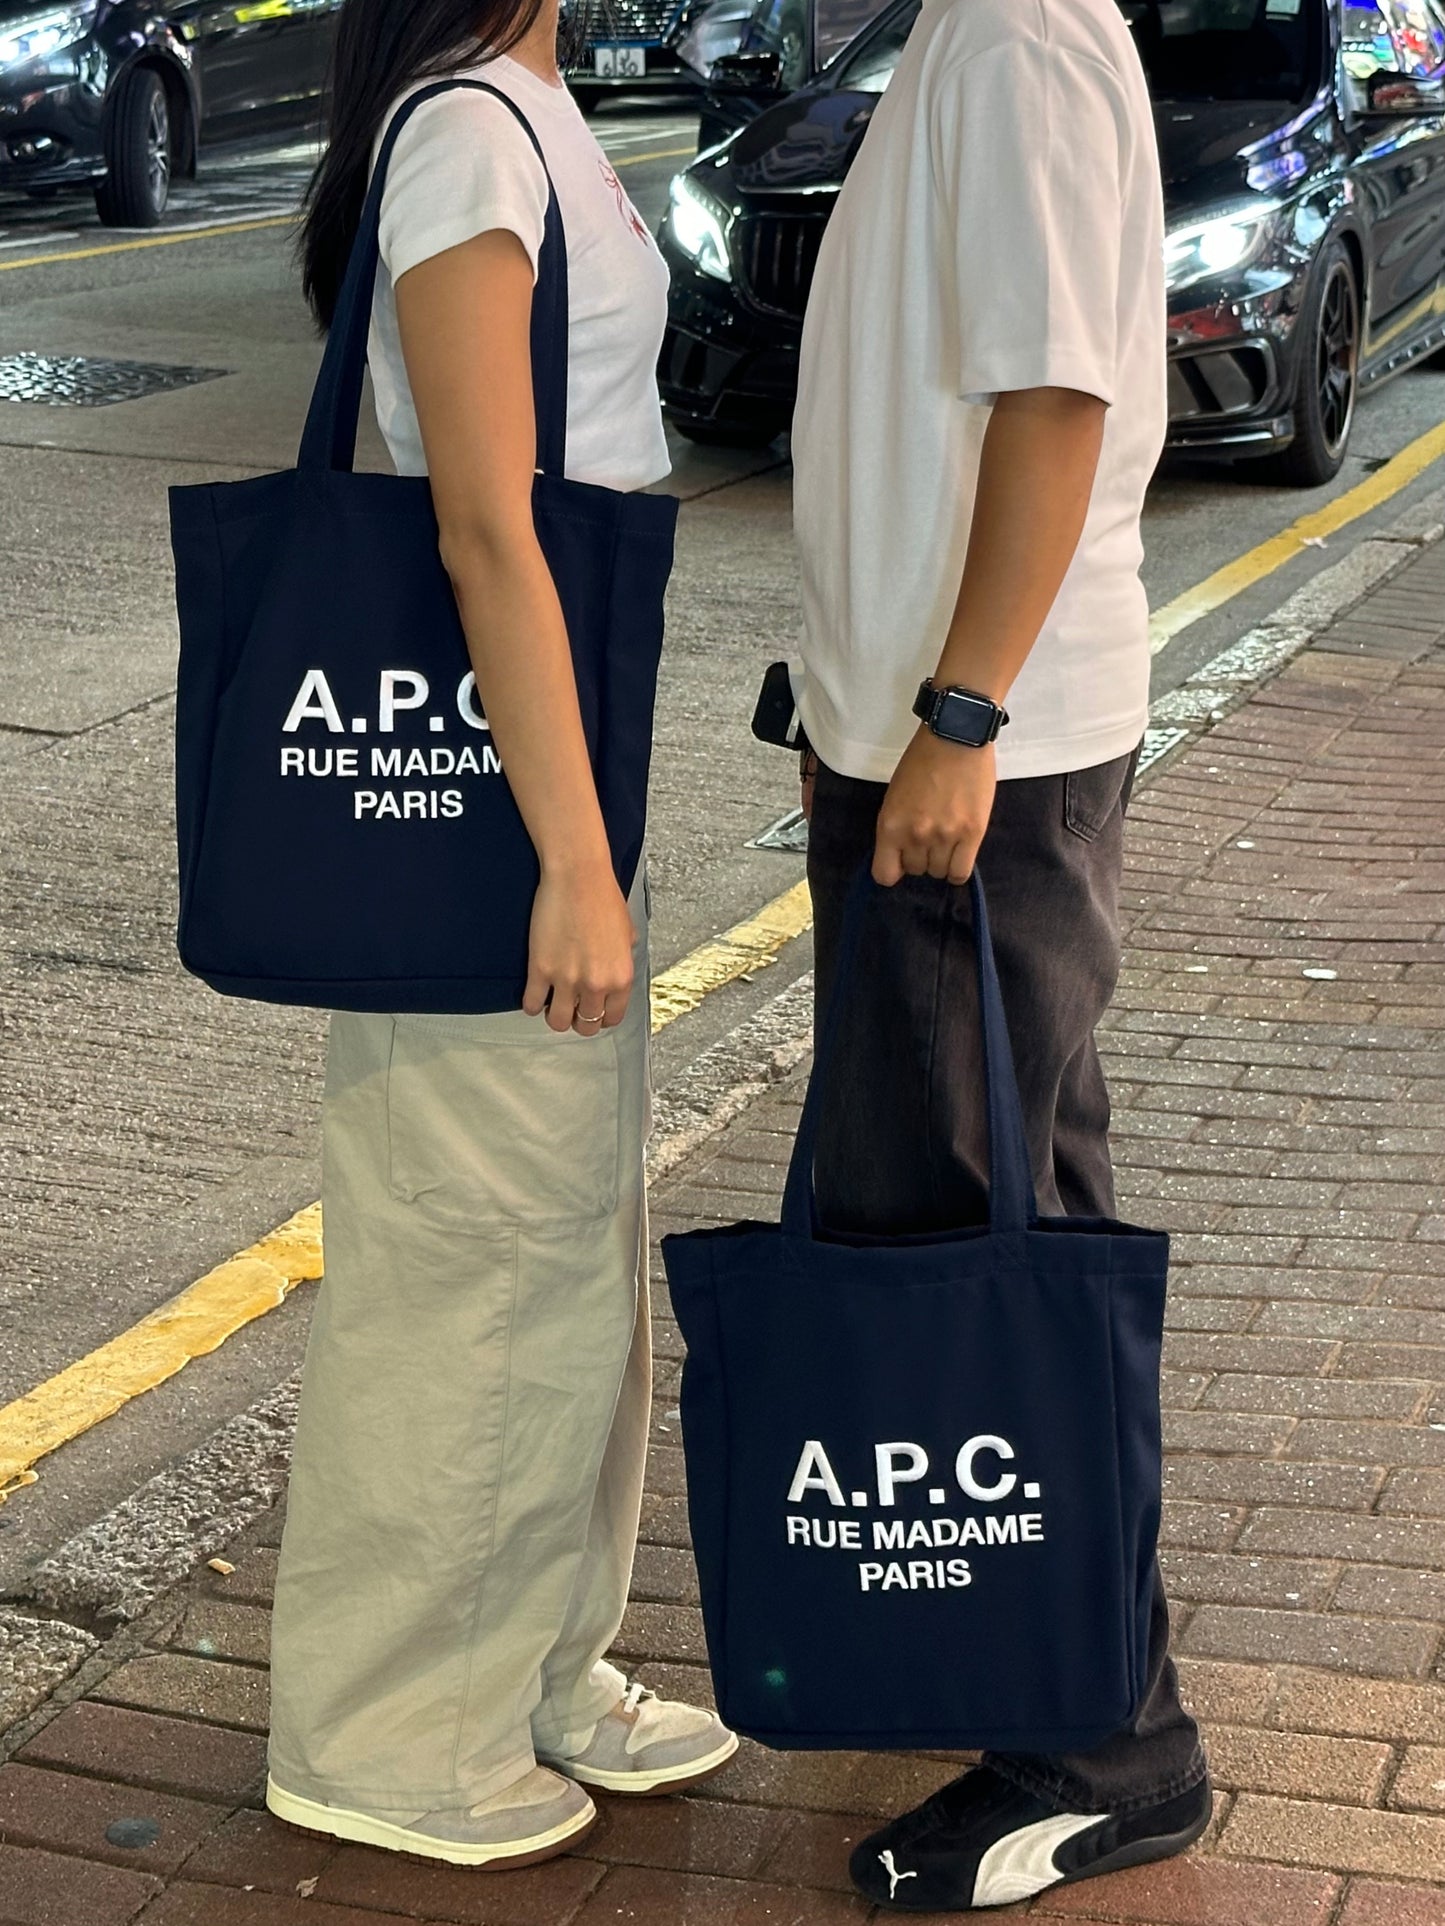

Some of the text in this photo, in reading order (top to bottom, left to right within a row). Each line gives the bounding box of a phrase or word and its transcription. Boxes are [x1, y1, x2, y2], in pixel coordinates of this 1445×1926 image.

[281, 748, 358, 776] RUE
[354, 790, 463, 819] PARIS
[787, 1434, 1041, 1507] A.P.C.
[786, 1513, 1044, 1550] RUE MADAME
[859, 1559, 972, 1592] PARIS
